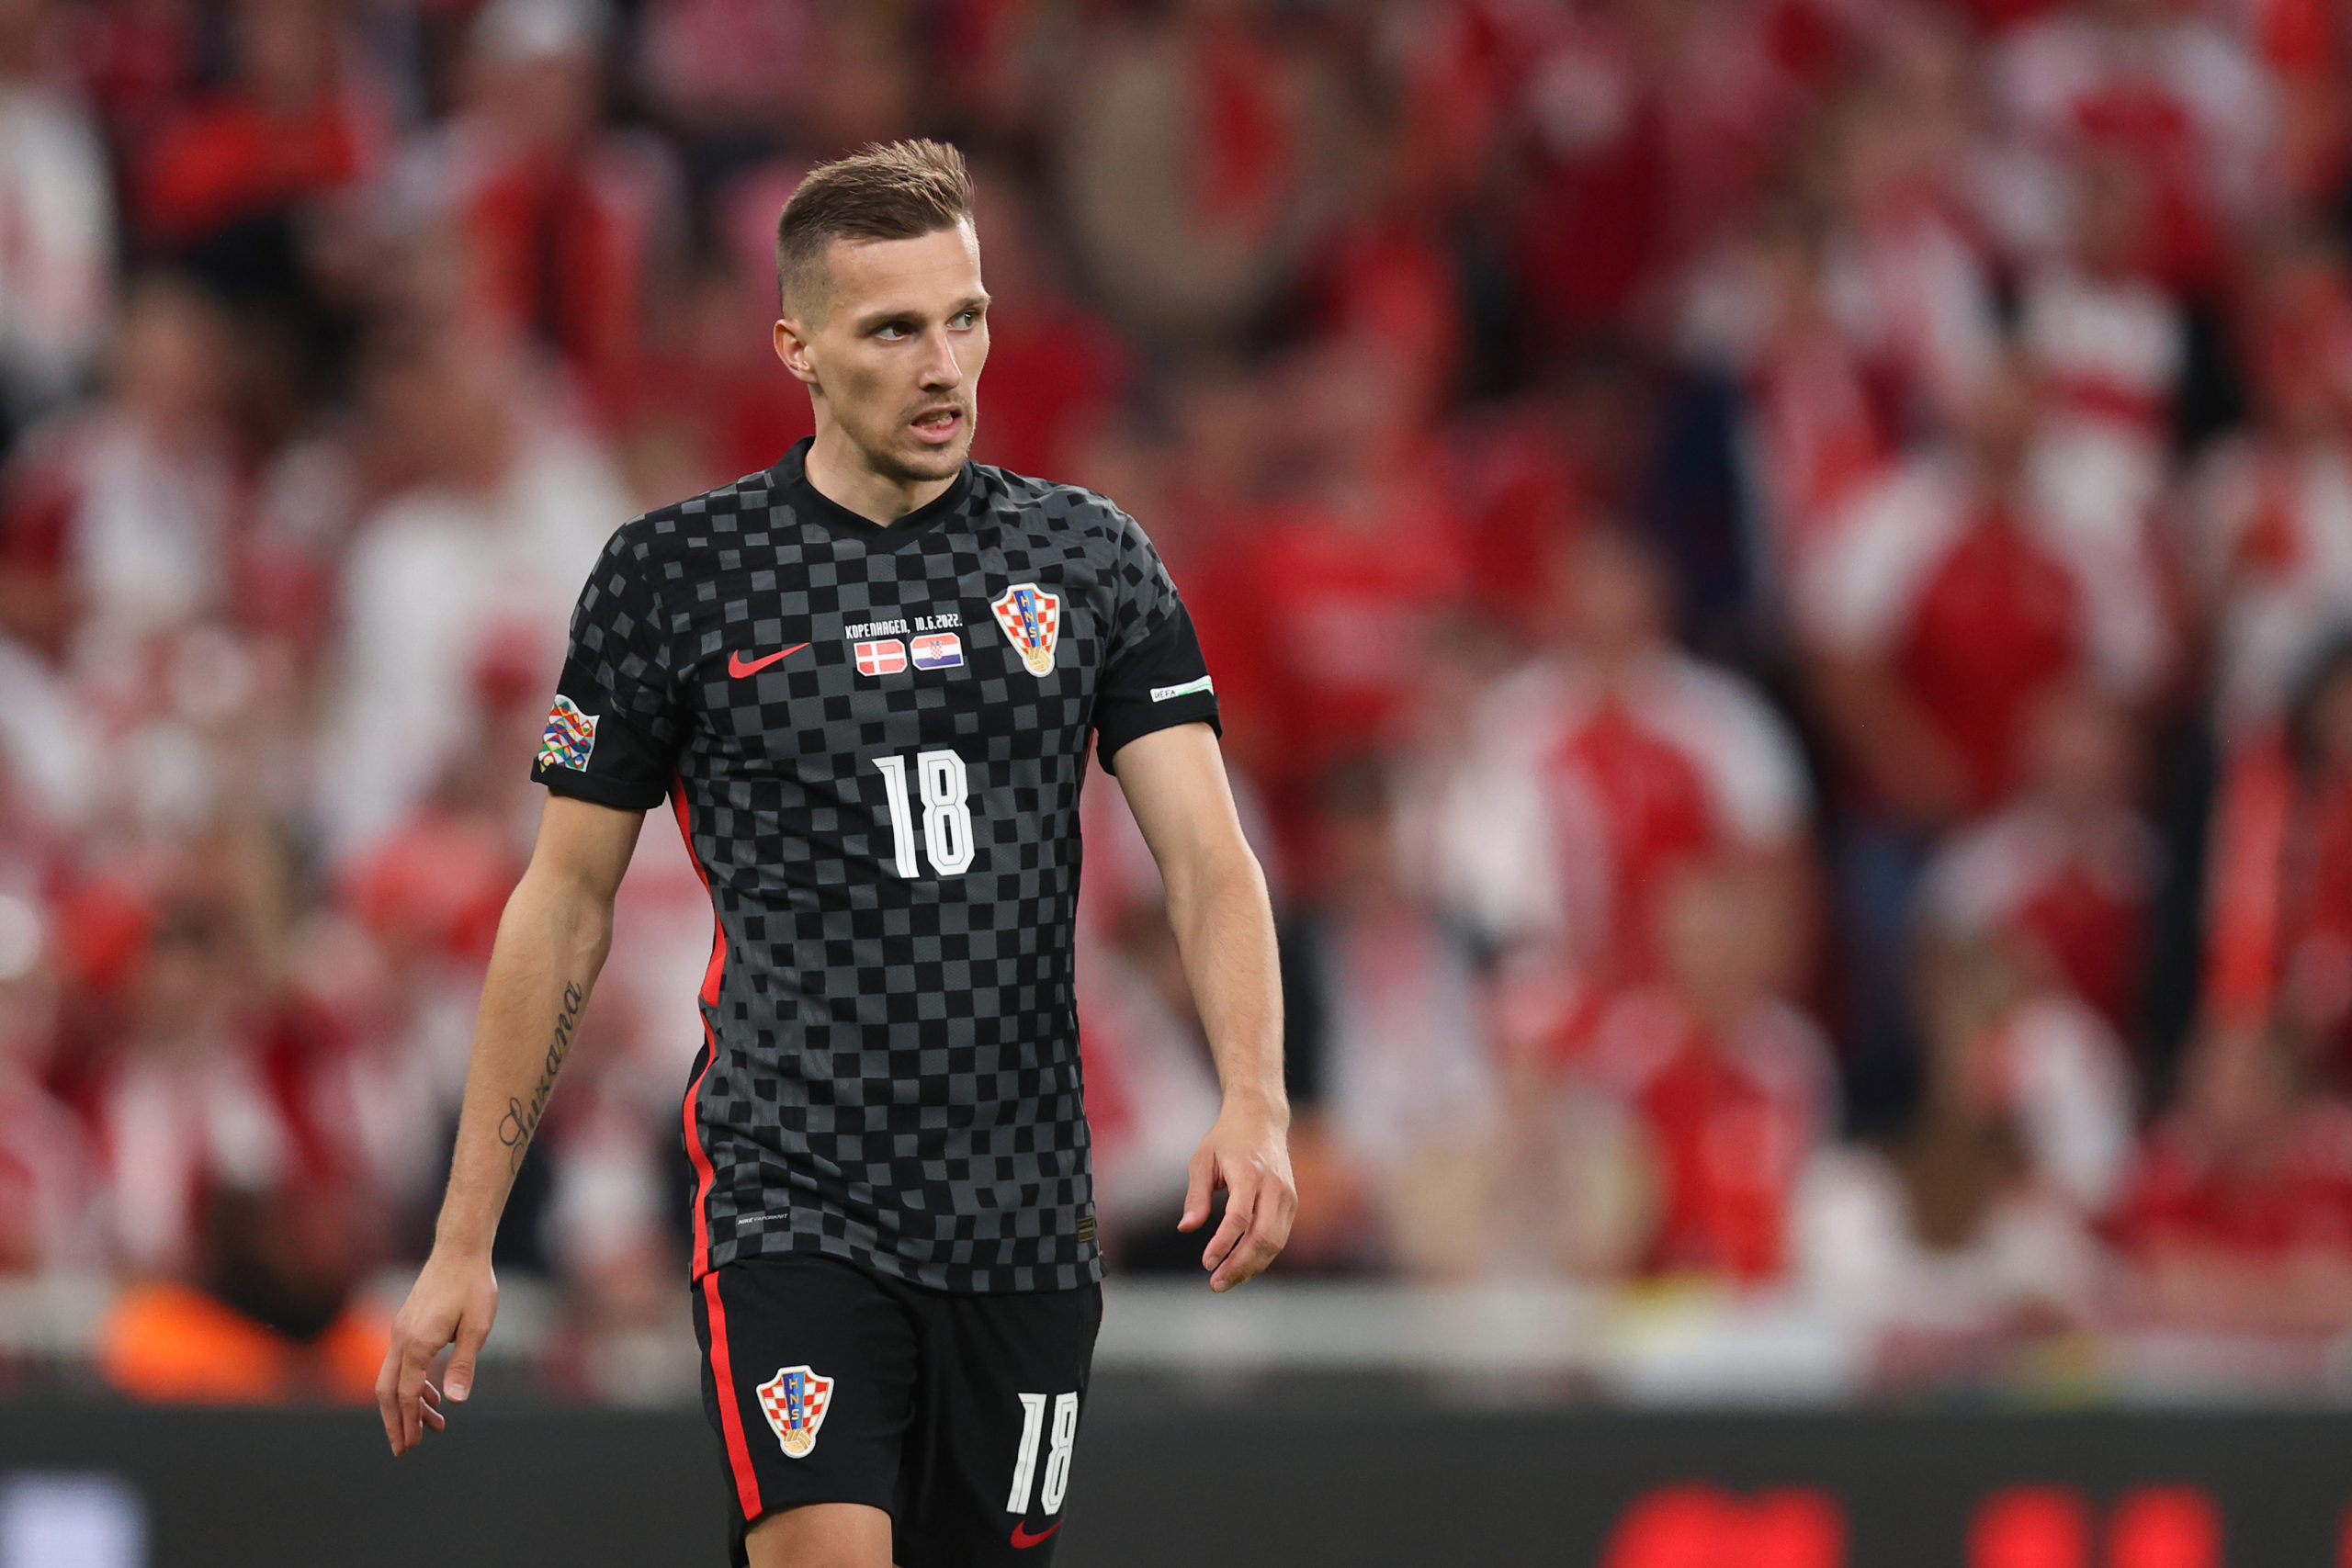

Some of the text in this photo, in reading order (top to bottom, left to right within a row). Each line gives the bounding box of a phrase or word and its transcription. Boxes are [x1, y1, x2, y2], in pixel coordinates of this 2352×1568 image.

[844, 613, 964, 640] KOPENHAGEN, 10.6.2022.
[1020, 594, 1038, 638] HNS
[1154, 690, 1177, 699] UEFA
[871, 749, 975, 878] 18
[788, 1378, 800, 1421] HNS
[1006, 1391, 1079, 1516] 18
